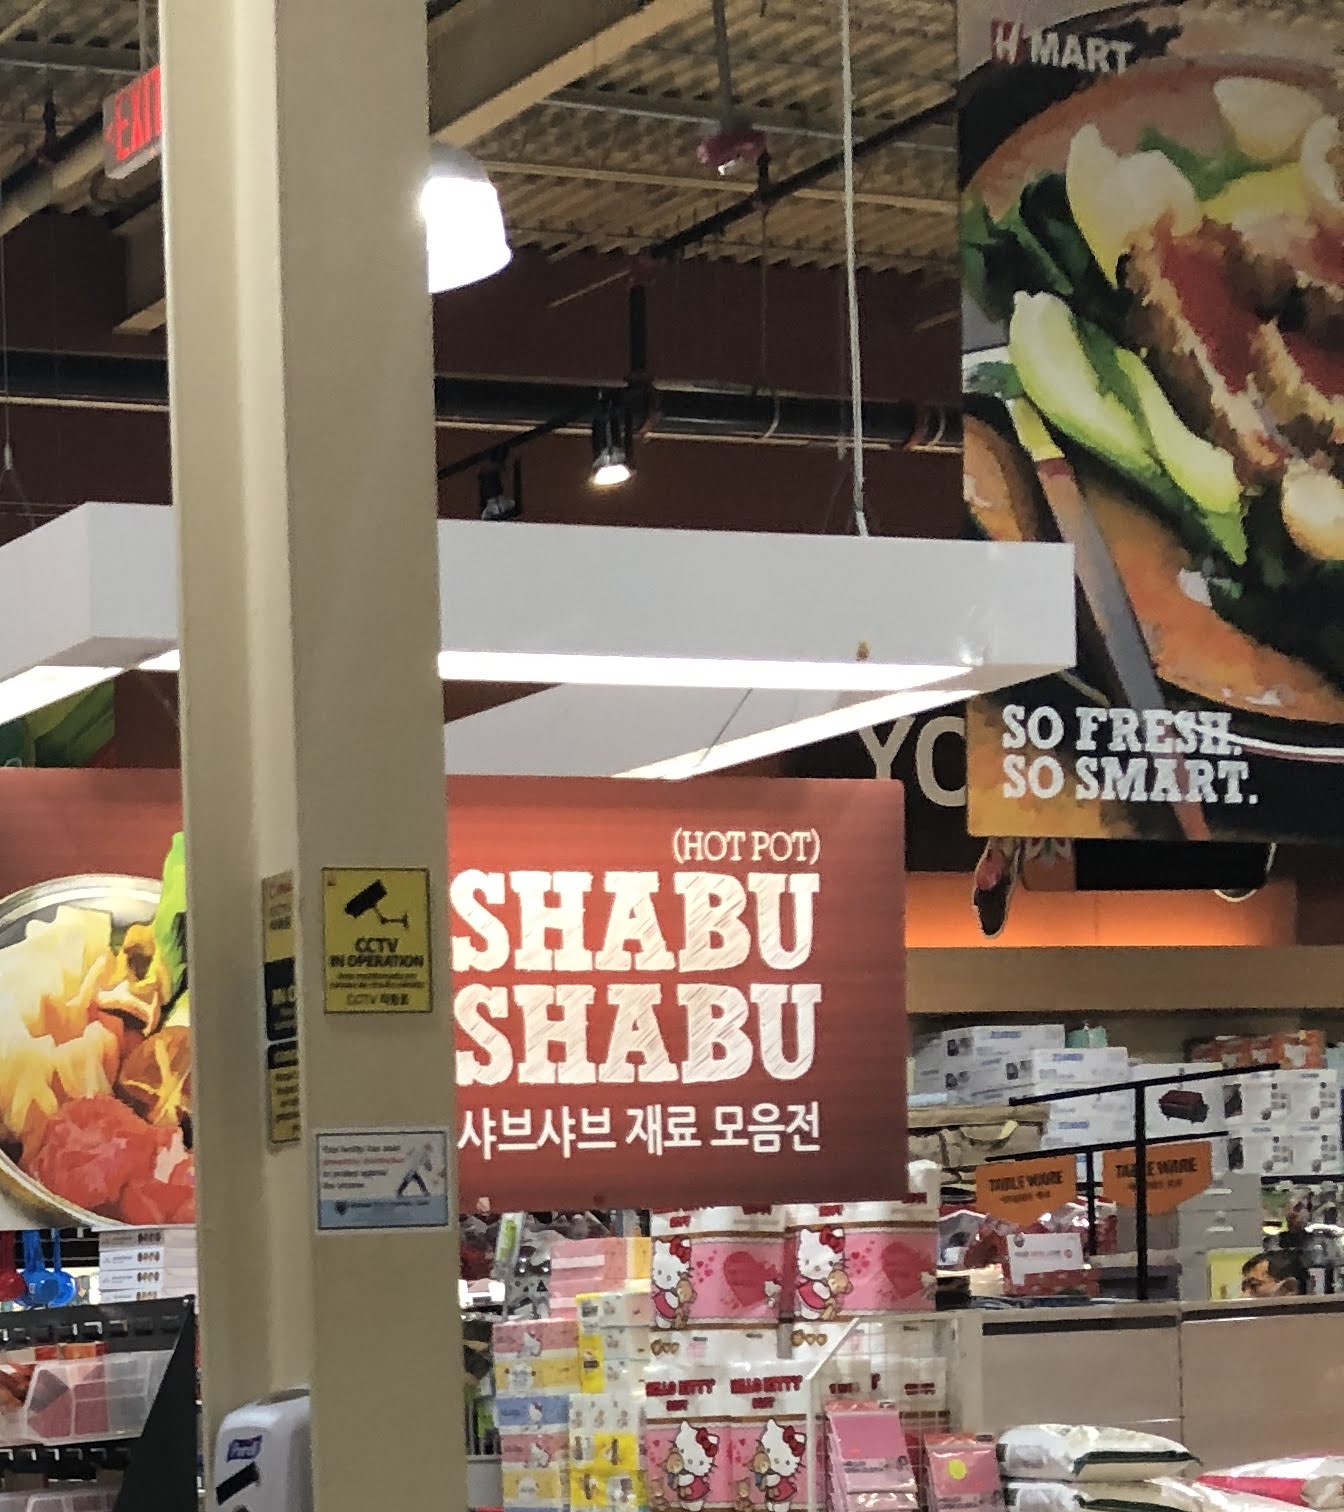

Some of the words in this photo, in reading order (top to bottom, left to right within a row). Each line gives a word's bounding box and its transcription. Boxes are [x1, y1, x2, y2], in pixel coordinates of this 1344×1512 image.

[1031, 30, 1134, 73] MART
[1002, 704, 1064, 749] SO
[1076, 707, 1243, 756] FRESH.
[1003, 755, 1065, 799] SO
[1076, 756, 1259, 805] SMART.
[673, 827, 746, 864] (HOT
[751, 828, 821, 865] POT)
[449, 868, 821, 973] SHABU
[329, 955, 345, 967] IN
[347, 955, 424, 967] OPERATION
[354, 937, 399, 953] CCTV
[453, 982, 823, 1085] SHABU
[457, 1104, 617, 1160] 샤브샤브
[625, 1103, 703, 1156] 재료
[710, 1101, 821, 1152] 모음전
[989, 1175, 1025, 1192] TABLE
[1026, 1171, 1063, 1188] WARE
[1156, 1157, 1198, 1174] WARE
